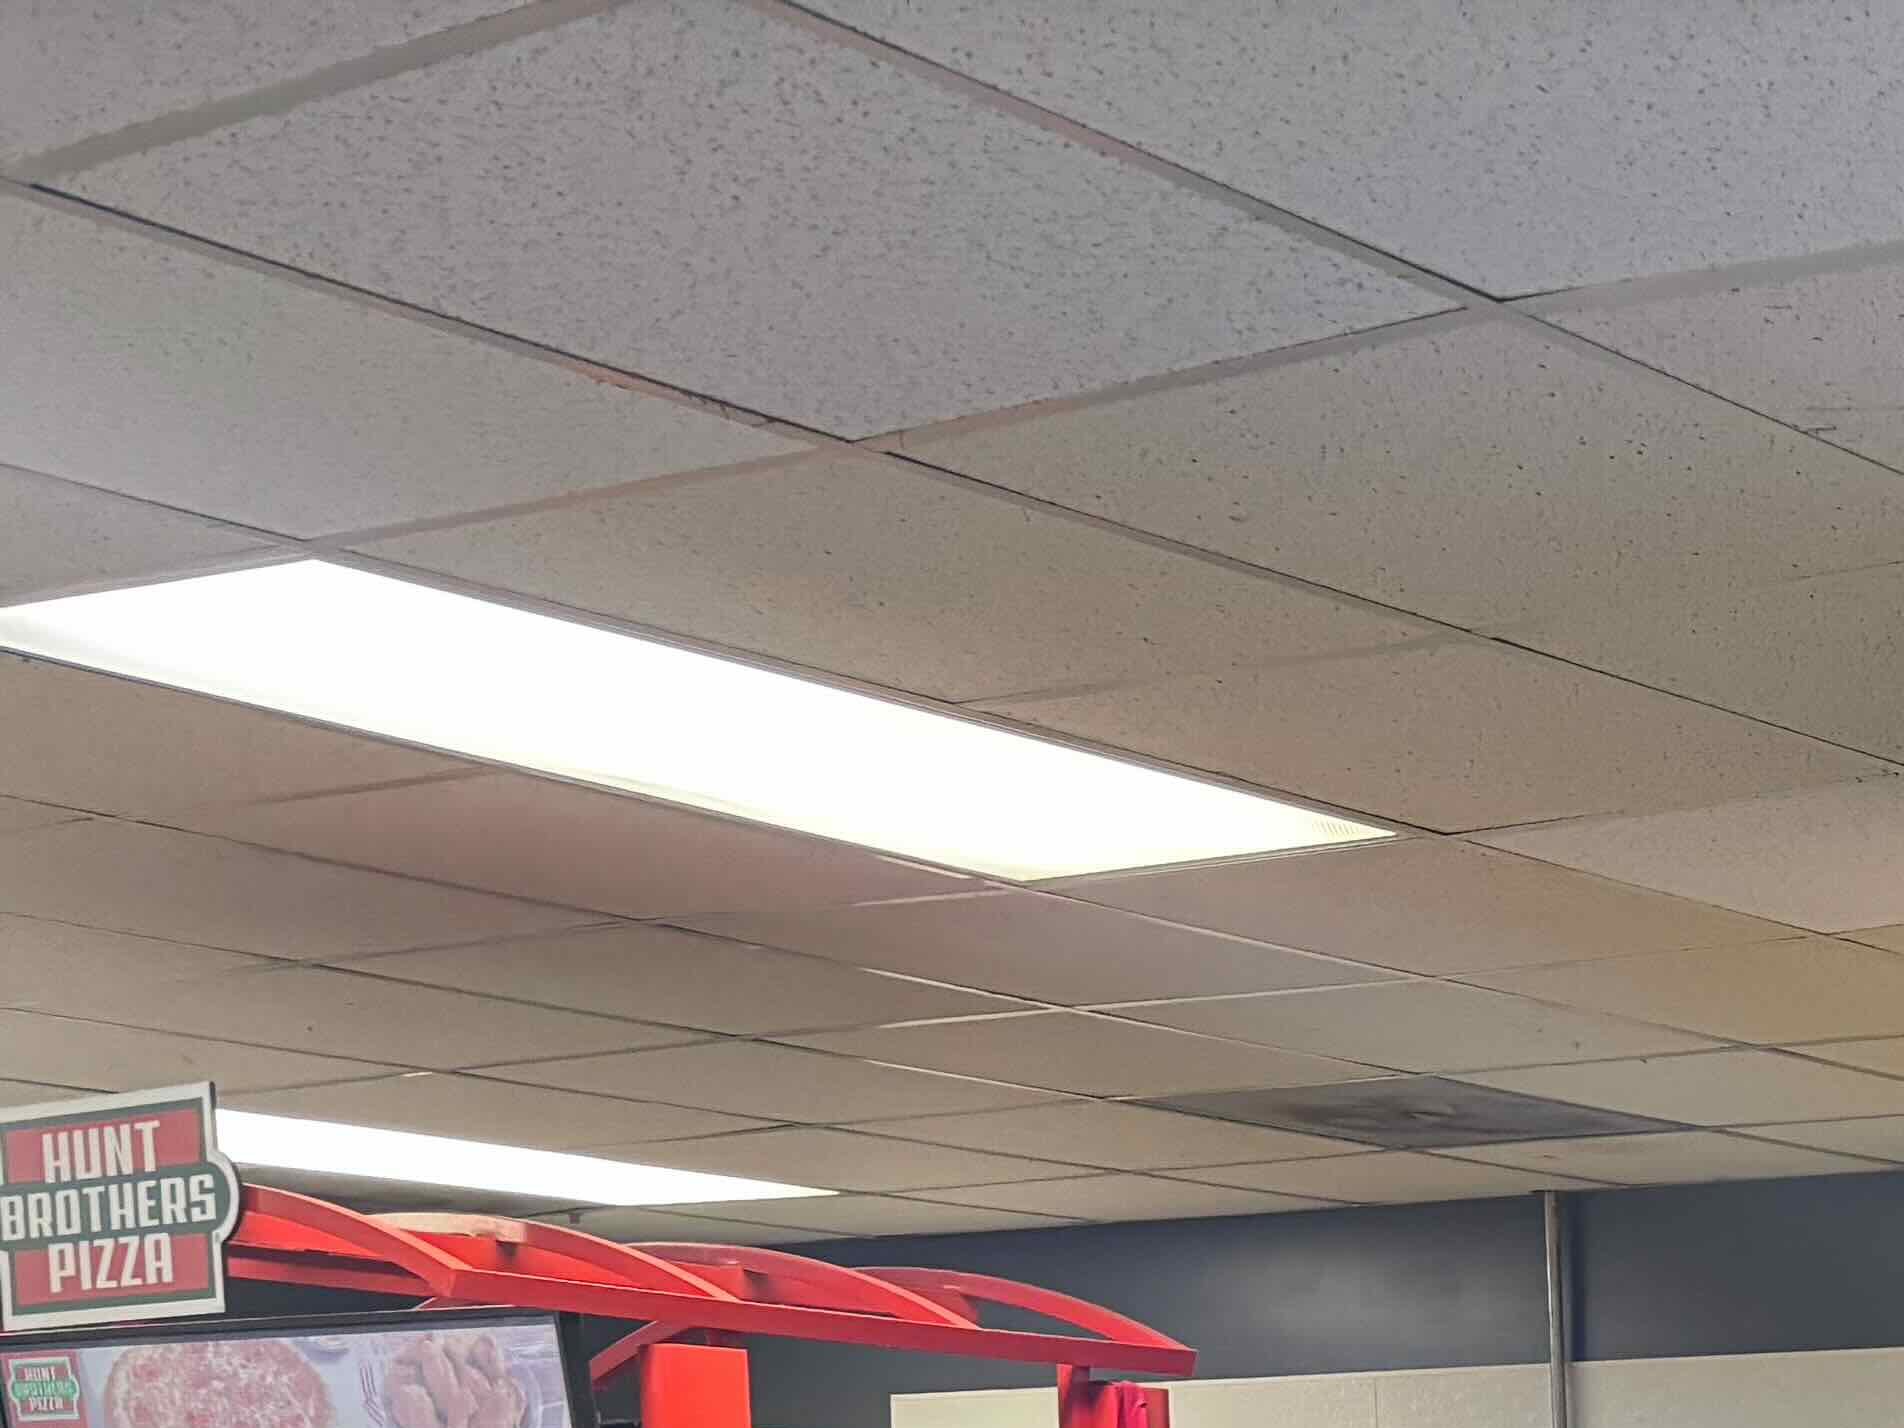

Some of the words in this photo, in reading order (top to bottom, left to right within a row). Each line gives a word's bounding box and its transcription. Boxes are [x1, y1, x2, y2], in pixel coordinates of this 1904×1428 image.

[42, 1120, 160, 1184] HUNT
[0, 1174, 217, 1241] BROTHERS
[48, 1232, 174, 1294] PIZZA
